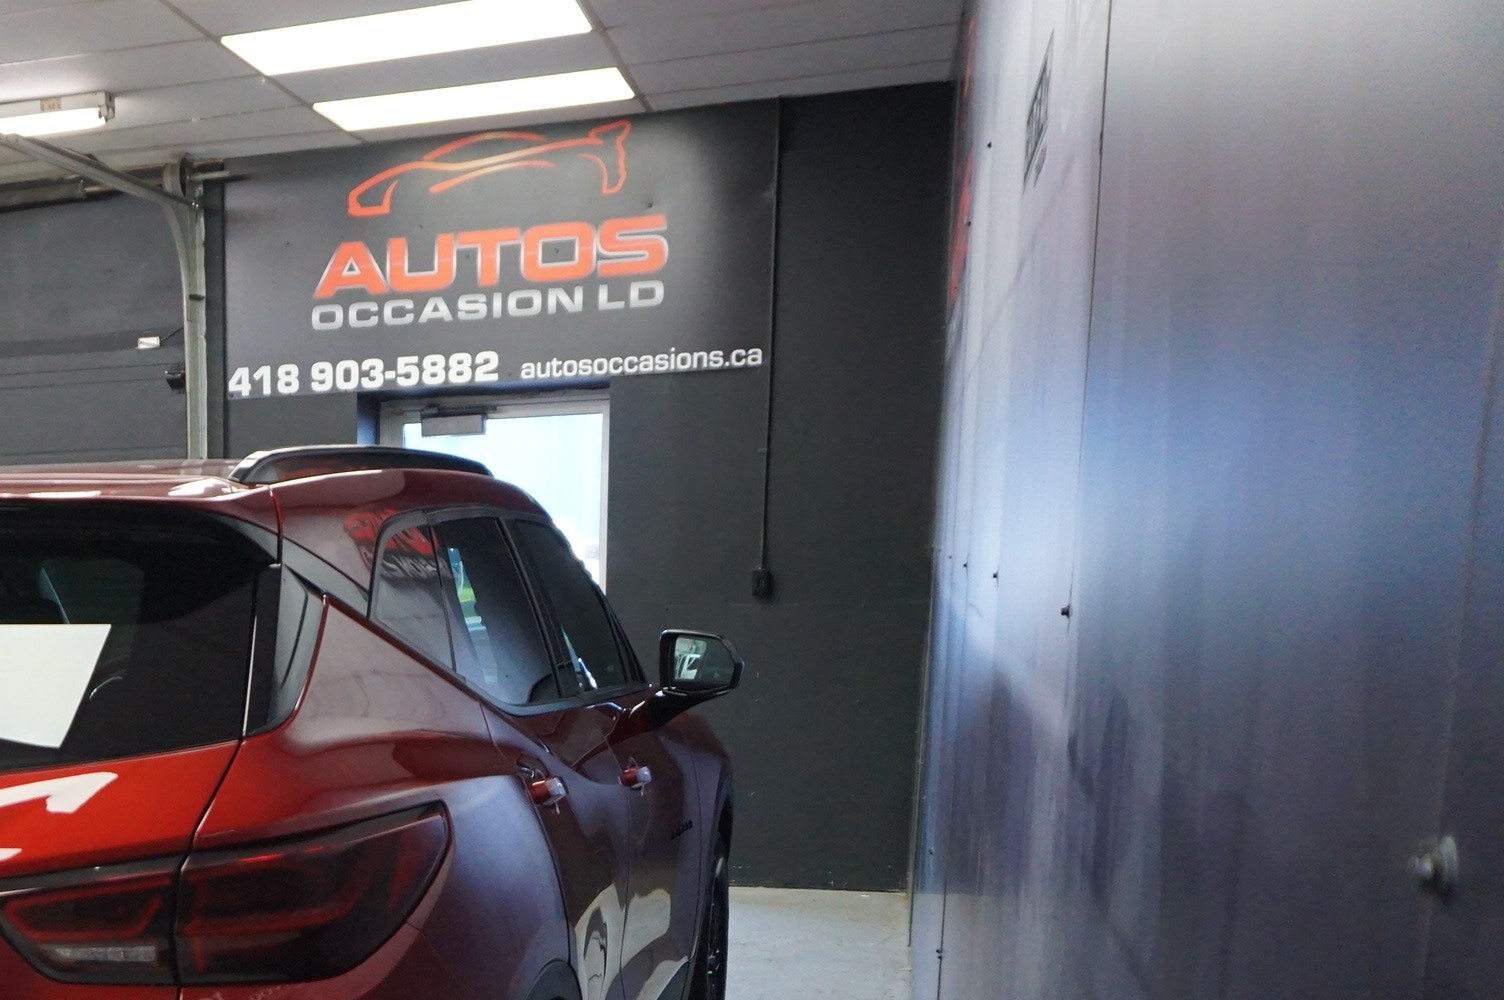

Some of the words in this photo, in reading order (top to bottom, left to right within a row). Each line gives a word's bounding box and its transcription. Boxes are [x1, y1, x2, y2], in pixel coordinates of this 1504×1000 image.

[312, 213, 670, 299] AUTOS
[310, 285, 584, 331] OCCASION
[598, 280, 665, 309] LD
[228, 362, 300, 398] 418
[310, 350, 500, 392] 903-5882
[520, 347, 764, 380] autosoccasions.ca
